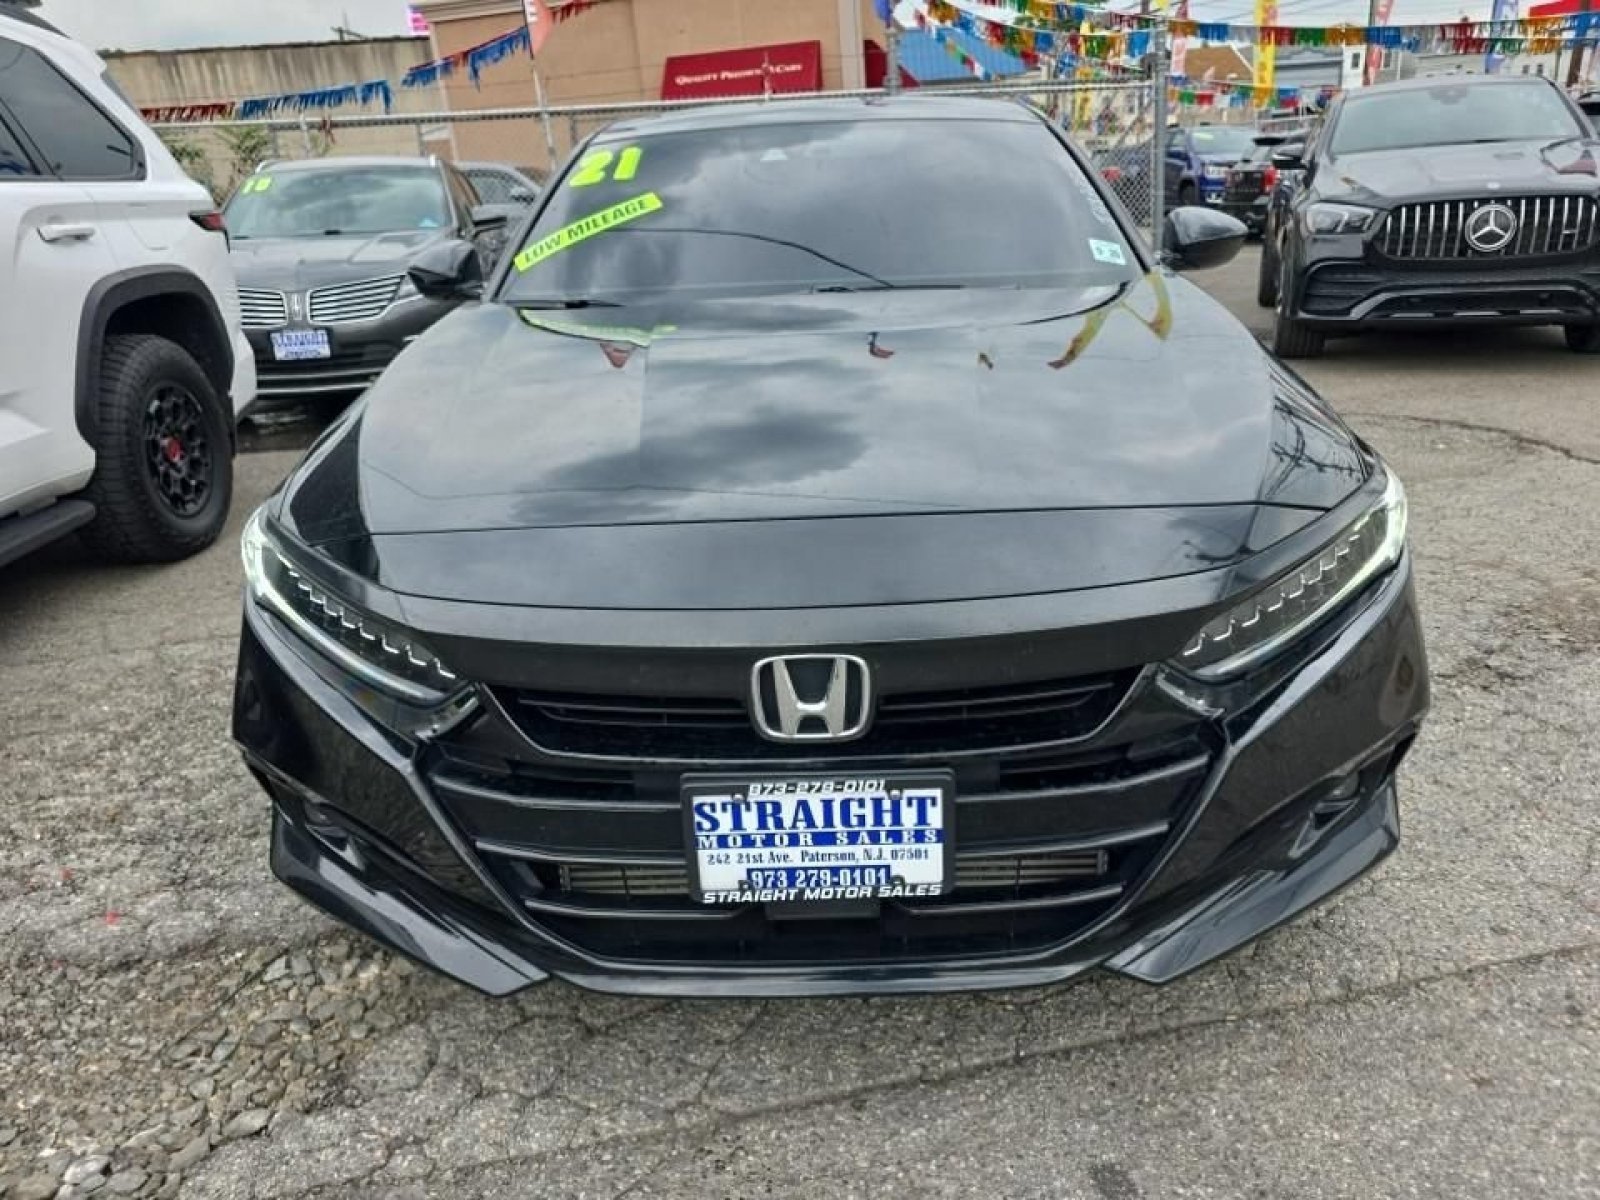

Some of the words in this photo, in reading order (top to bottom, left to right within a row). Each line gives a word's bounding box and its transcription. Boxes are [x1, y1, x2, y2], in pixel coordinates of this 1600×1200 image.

[569, 147, 642, 187] 21
[524, 234, 561, 264] LOW
[567, 198, 648, 241] MILEAGE
[749, 780, 885, 796] 973-279-0101
[694, 796, 937, 832] STRAIGHT
[698, 832, 814, 850] MOTOR
[836, 829, 937, 845] SALES
[707, 852, 731, 865] 242
[737, 851, 763, 864] 21st
[768, 850, 795, 863] Ave.
[801, 849, 859, 863] Paterson,
[891, 847, 929, 860] 07501
[751, 870, 788, 888] 973
[795, 867, 887, 887] 279-0101
[703, 888, 799, 904] STRAIGHT
[804, 886, 873, 901] MOTOR
[878, 884, 943, 898] SALES
